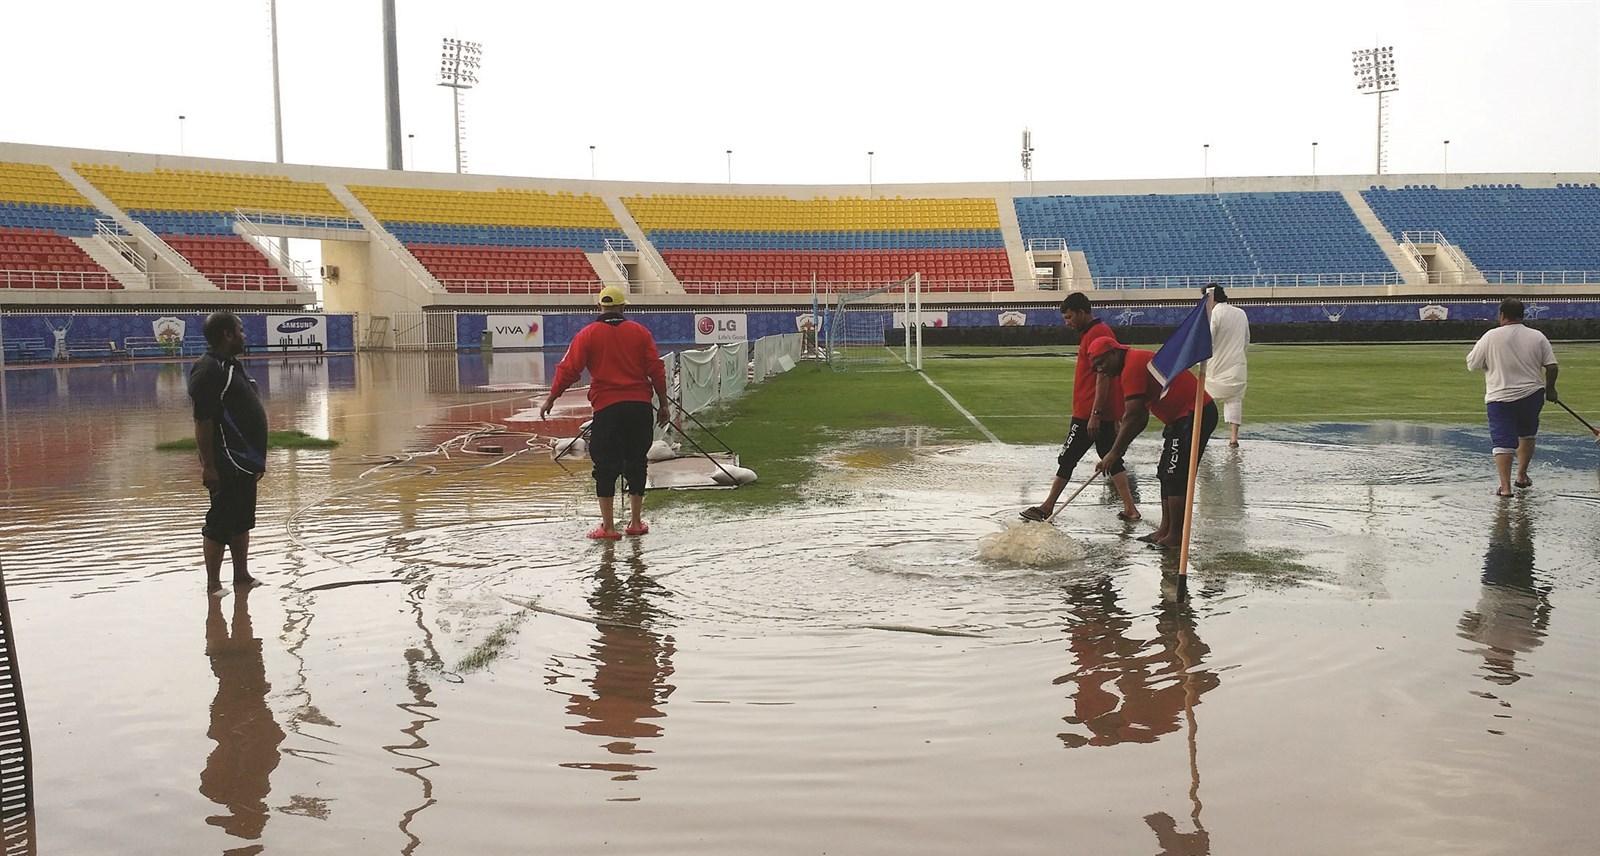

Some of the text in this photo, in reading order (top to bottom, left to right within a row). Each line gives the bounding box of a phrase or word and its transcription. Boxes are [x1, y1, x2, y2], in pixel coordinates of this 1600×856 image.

[281, 321, 314, 329] SAMSUNG
[495, 325, 524, 335] VIVA
[718, 319, 737, 332] LG
